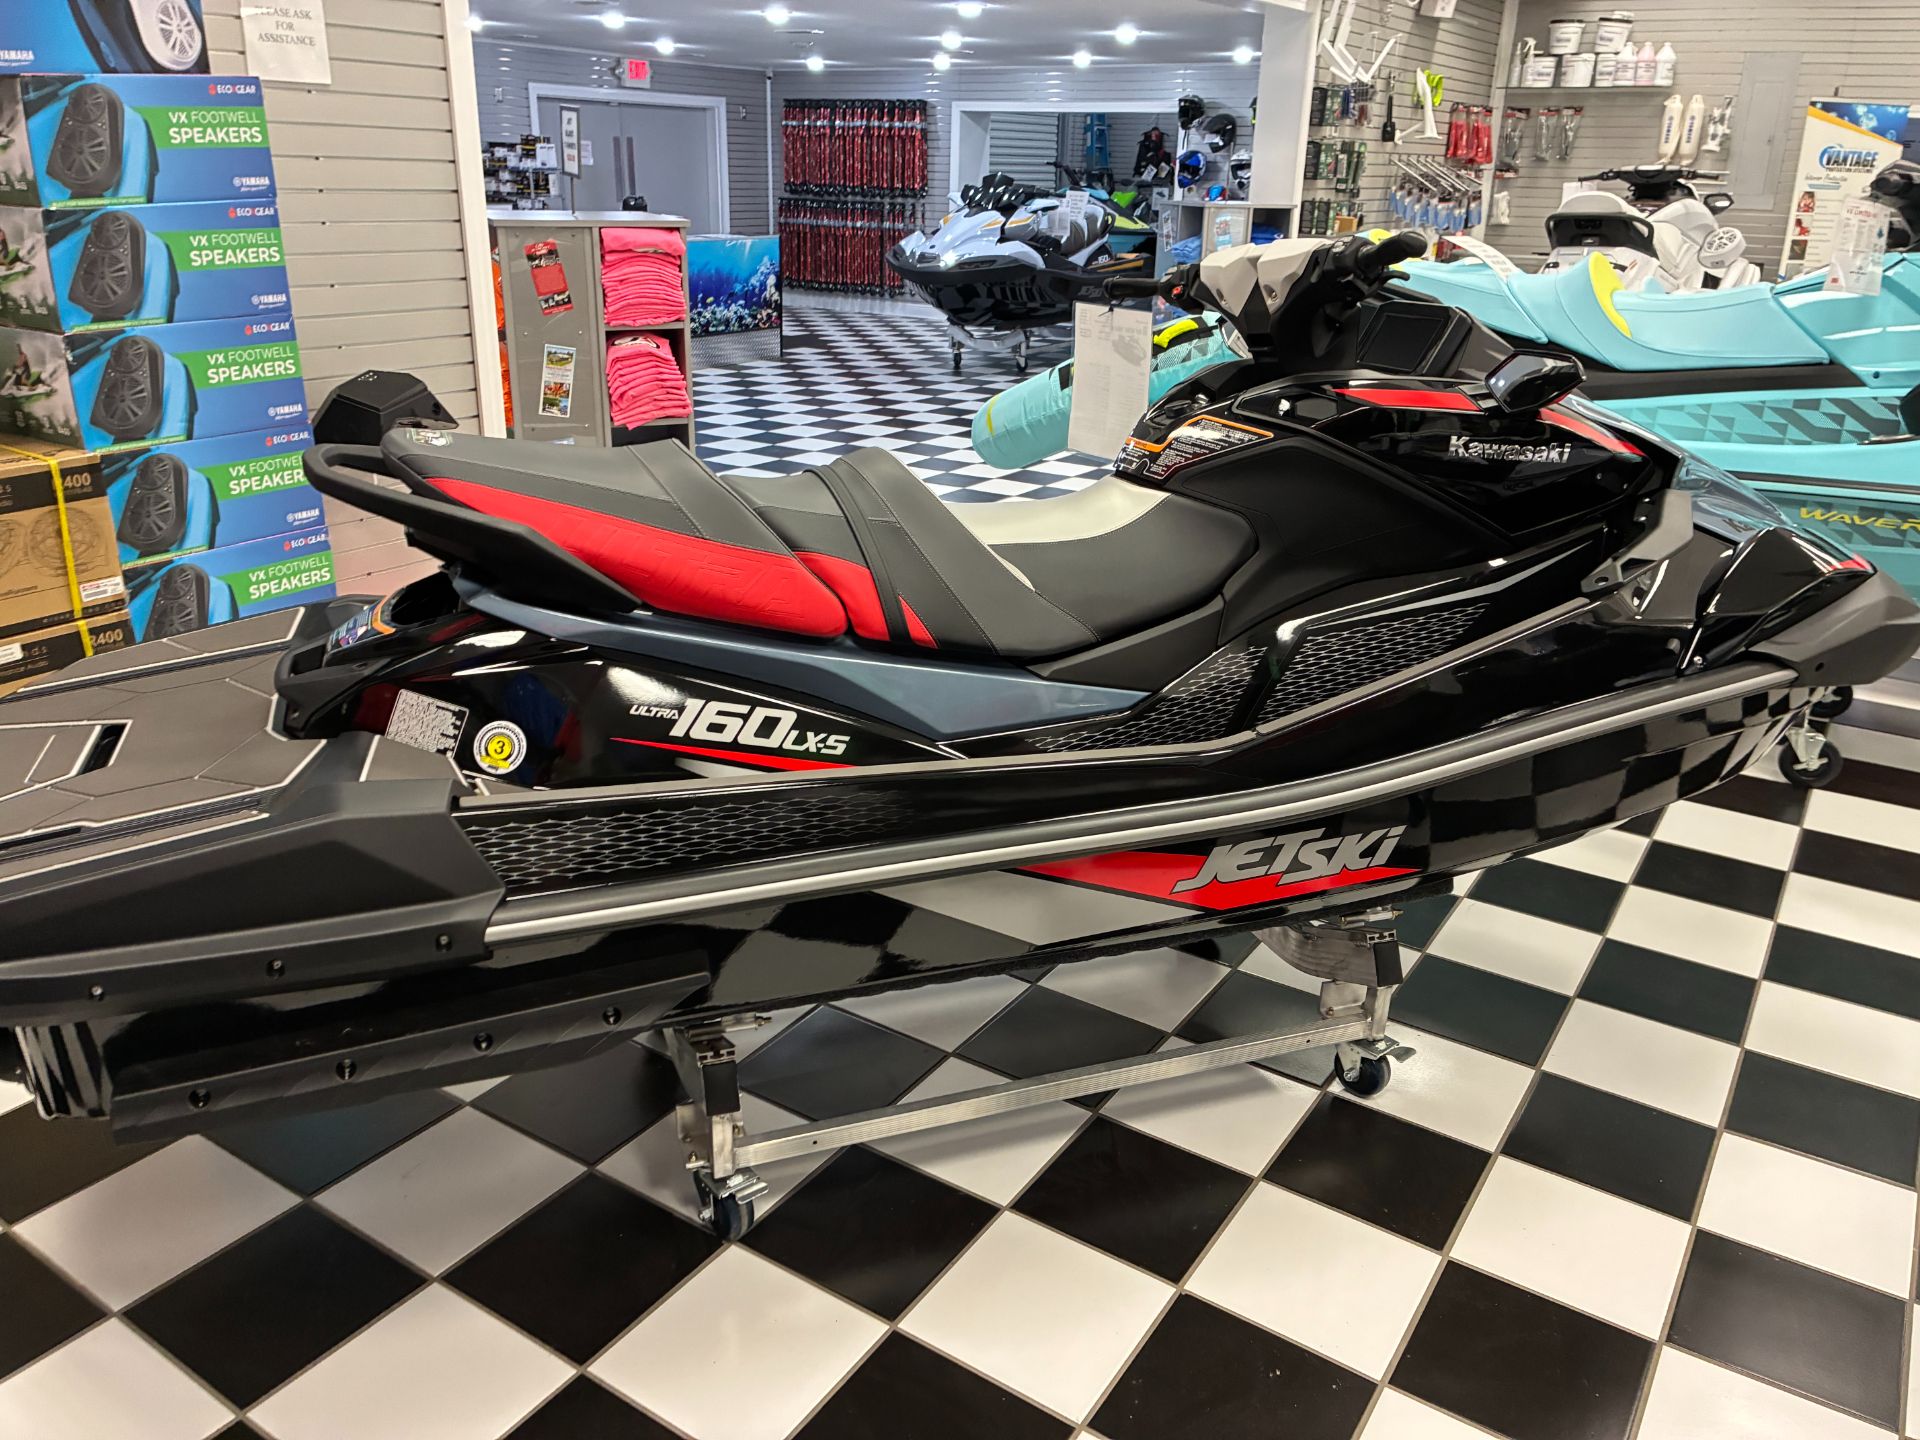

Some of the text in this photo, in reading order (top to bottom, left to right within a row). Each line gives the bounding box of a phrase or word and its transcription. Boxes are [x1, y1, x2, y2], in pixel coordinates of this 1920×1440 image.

[292, 10, 313, 20] ASK
[274, 20, 296, 32] FOR
[257, 32, 317, 47] ASSISTANCE
[168, 111, 261, 124] VX FOOTWELL
[168, 126, 263, 144] SPEAKERS
[1826, 151, 1879, 168] VANTAGE
[189, 232, 279, 247] VX FOOTWELL
[189, 246, 281, 267] SPEAKERS
[206, 345, 295, 365] VX FOOTWELL
[207, 359, 296, 384] SPEAKERS
[1448, 435, 1572, 463] Kawasaki
[228, 464, 247, 478] VX
[53, 472, 92, 490] 400
[228, 469, 307, 495] SPEAKER
[248, 556, 329, 582] VX FOOTWELL
[248, 567, 331, 599] SPEAKERS
[629, 697, 851, 756] ULTRA 160 LX-S
[494, 740, 506, 755] 3
